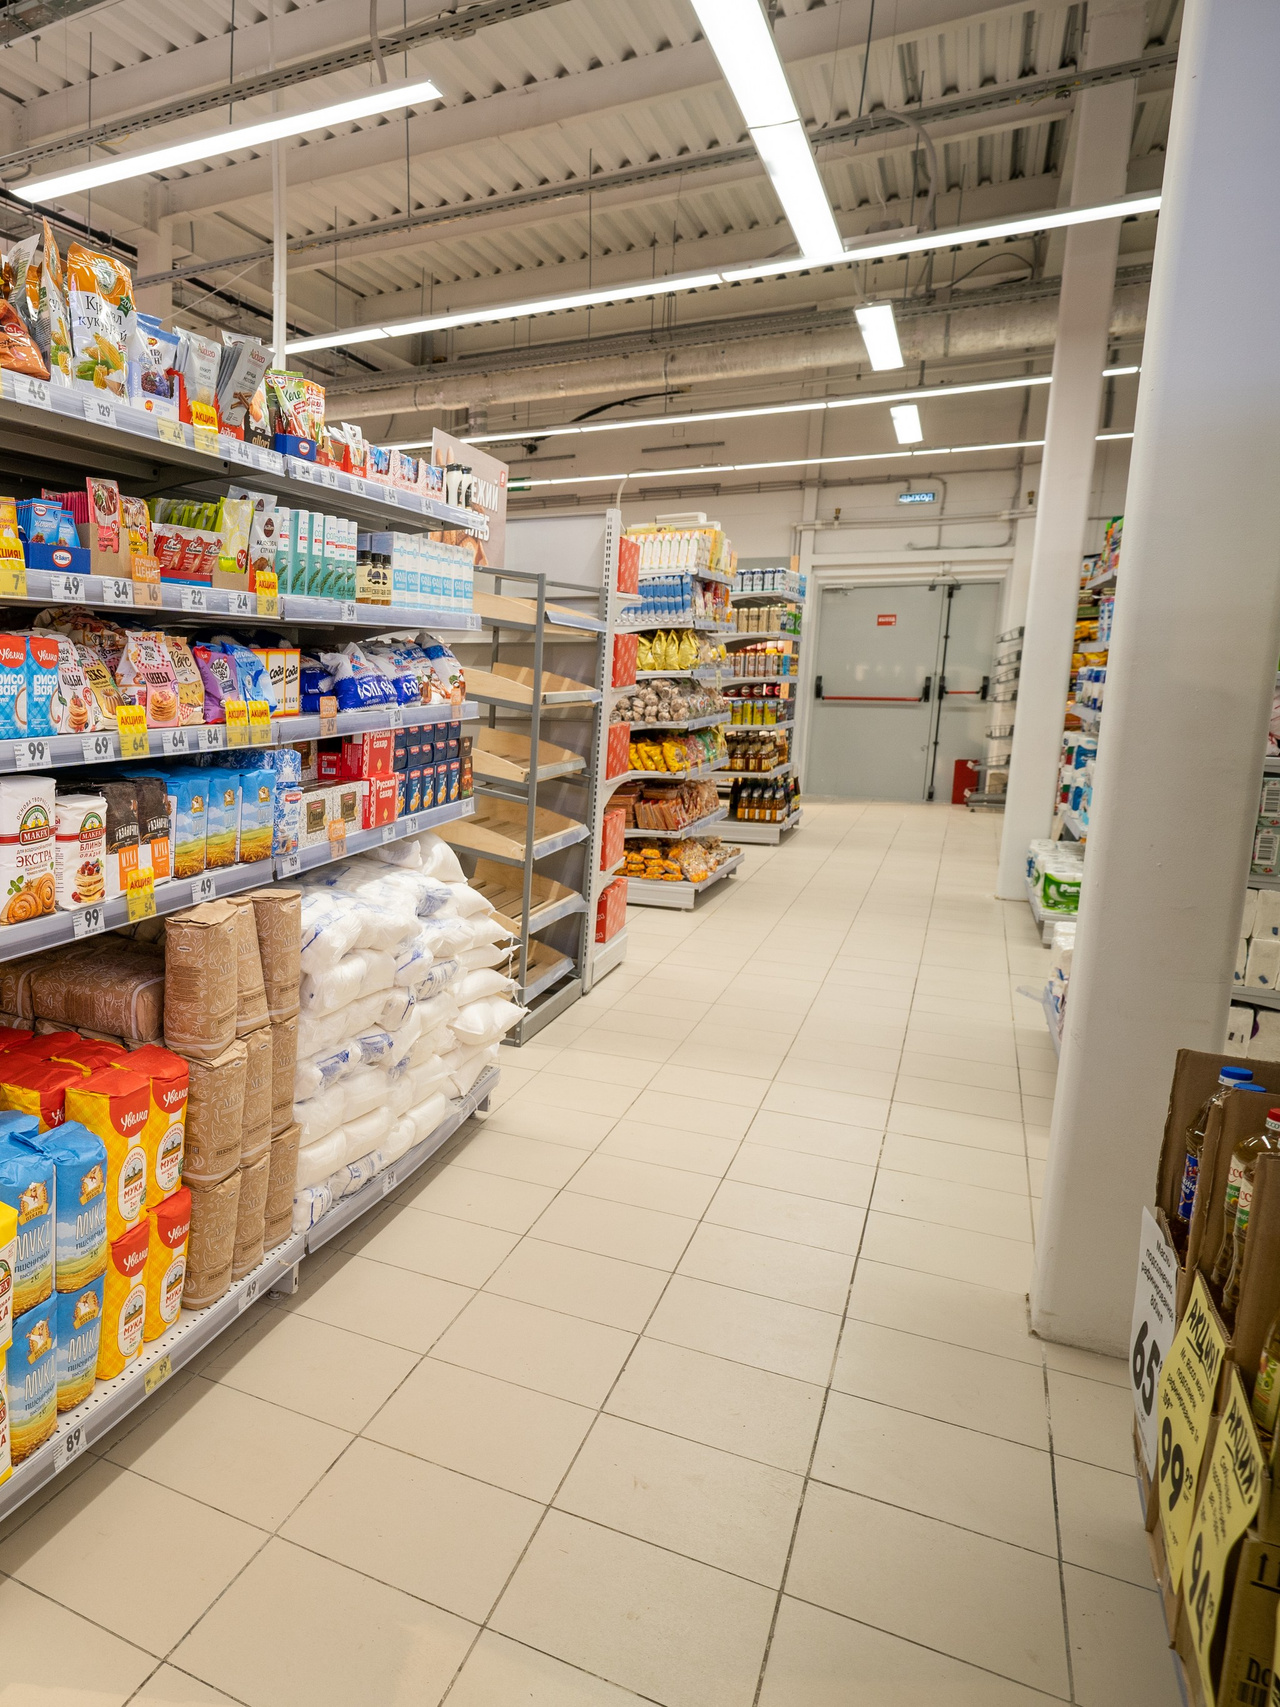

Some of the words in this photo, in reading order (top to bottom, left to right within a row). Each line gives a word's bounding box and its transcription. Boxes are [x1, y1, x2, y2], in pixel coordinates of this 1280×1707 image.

[28, 379, 46, 401] 46
[96, 402, 111, 417] 129
[195, 409, 216, 426] АКЦИЯ!
[237, 443, 249, 460] 44
[471, 475, 499, 512] ЕЖИЙ
[134, 556, 157, 568] ЛУЧШАЯ
[12, 574, 20, 590] 7
[135, 567, 158, 580] ЦЕНА!
[64, 577, 80, 595] 49
[114, 580, 129, 600] 34
[147, 584, 158, 602] 16
[258, 579, 277, 590] АКЦИЯ!
[191, 590, 203, 606] 22
[237, 594, 248, 610] 24
[347, 604, 355, 616] 59
[37, 649, 58, 662] Увелка
[270, 665, 284, 680] Сода
[286, 664, 299, 679] Сода
[120, 714, 144, 726] АКЦИЯ!
[228, 709, 246, 719] АКЦИЯ!
[251, 709, 269, 719] АКЦИЯ!
[327, 721, 335, 733] 29
[172, 730, 184, 748] 64
[207, 729, 218, 744] 84
[372, 739, 388, 750] сахар
[28, 741, 45, 761] 99
[94, 736, 109, 755] 69
[132, 740, 144, 751] 64
[376, 776, 396, 791] Русский
[379, 788, 393, 799] сахар
[23, 829, 47, 842] MAKFA
[81, 828, 103, 840] MAKFA
[79, 840, 102, 852] БЛИНЫ
[153, 840, 168, 857] МУКА
[15, 850, 53, 868] ЭКСТРА
[120, 850, 137, 867] МУКА
[129, 876, 152, 890] АКЦИЯ!
[200, 878, 212, 895] 49
[144, 901, 153, 913] 54
[84, 909, 99, 928] 99
[163, 1087, 188, 1108] Увелка
[120, 1109, 148, 1131] Увелка
[160, 1154, 179, 1171] МУКА
[123, 1181, 144, 1200] МУКА
[75, 1199, 106, 1241] МУКА
[245, 1281, 257, 1298] 49
[123, 1316, 143, 1336] МУКА
[1185, 1297, 1221, 1387] АКЦИЯ!
[158, 1361, 168, 1375] 99
[1132, 1320, 1161, 1417] 65
[66, 1429, 81, 1453] 89
[1224, 1397, 1261, 1506] АКЦИЯ!
[1160, 1415, 1185, 1513] 99
[1189, 1530, 1211, 1654] 94
